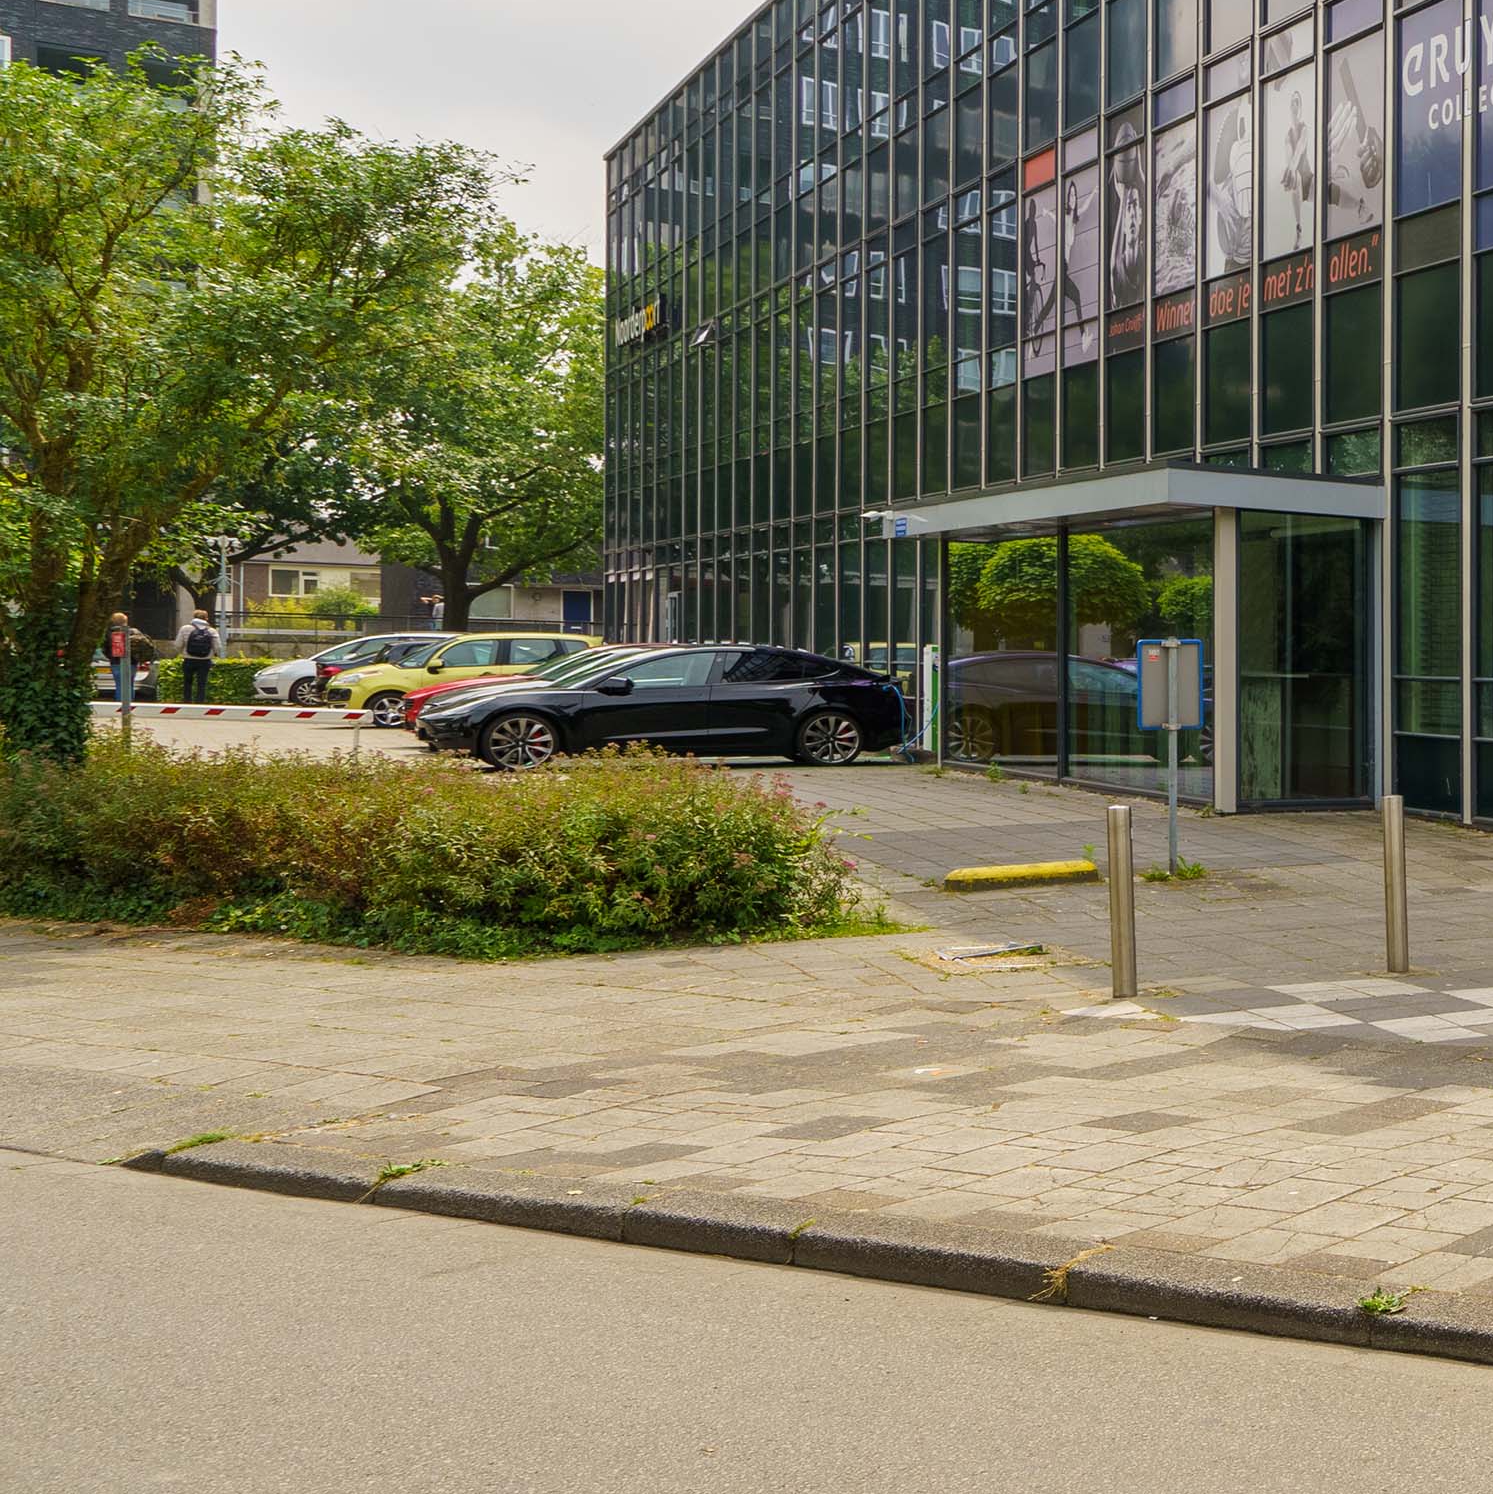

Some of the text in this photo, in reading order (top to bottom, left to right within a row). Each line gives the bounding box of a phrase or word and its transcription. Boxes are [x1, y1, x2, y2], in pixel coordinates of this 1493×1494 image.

[1209, 286, 1233, 317] doe
[1237, 277, 1250, 317] je
[1263, 263, 1292, 302] met
[1295, 256, 1313, 294] z'n
